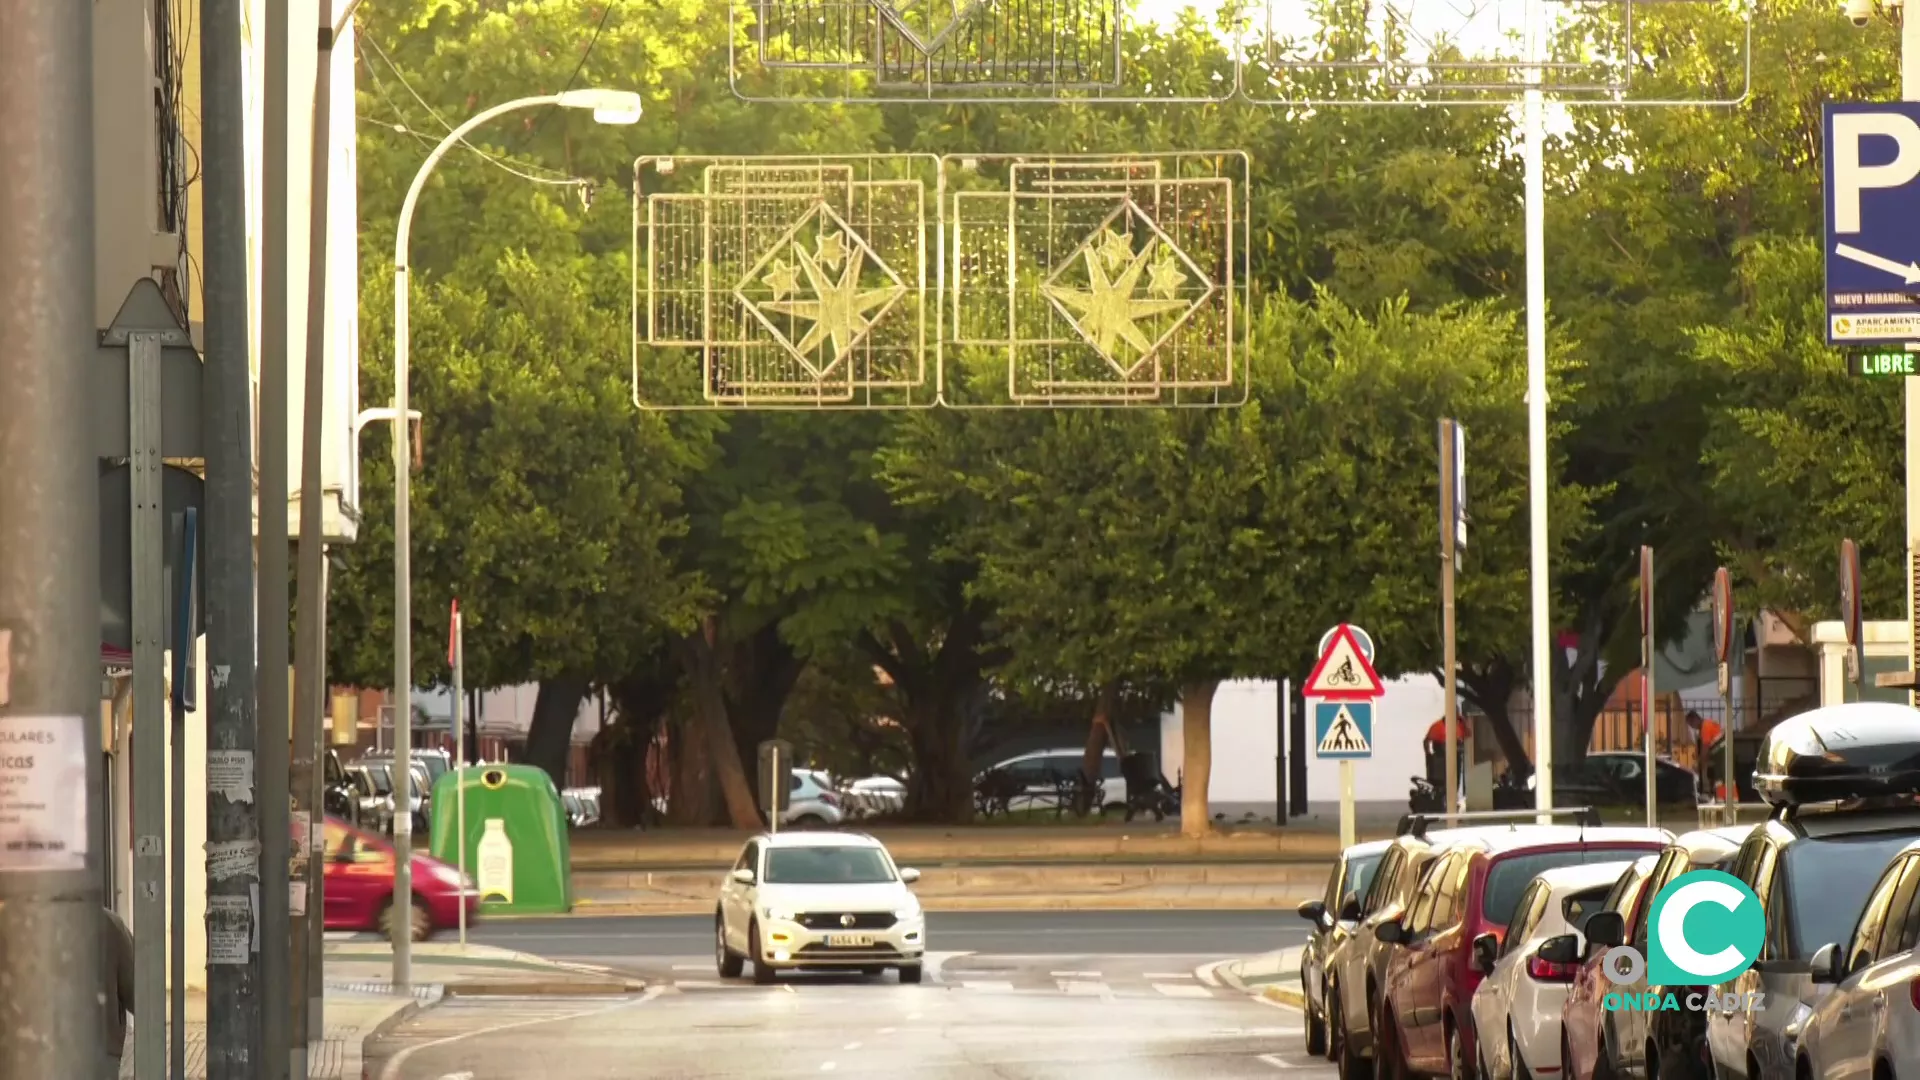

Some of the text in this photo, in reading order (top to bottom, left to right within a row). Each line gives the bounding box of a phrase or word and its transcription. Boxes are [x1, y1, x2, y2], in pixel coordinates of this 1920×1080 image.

[1833, 113, 1920, 233] P
[1834, 293, 1863, 305] NUEVO
[1862, 353, 1915, 375] LIBRE
